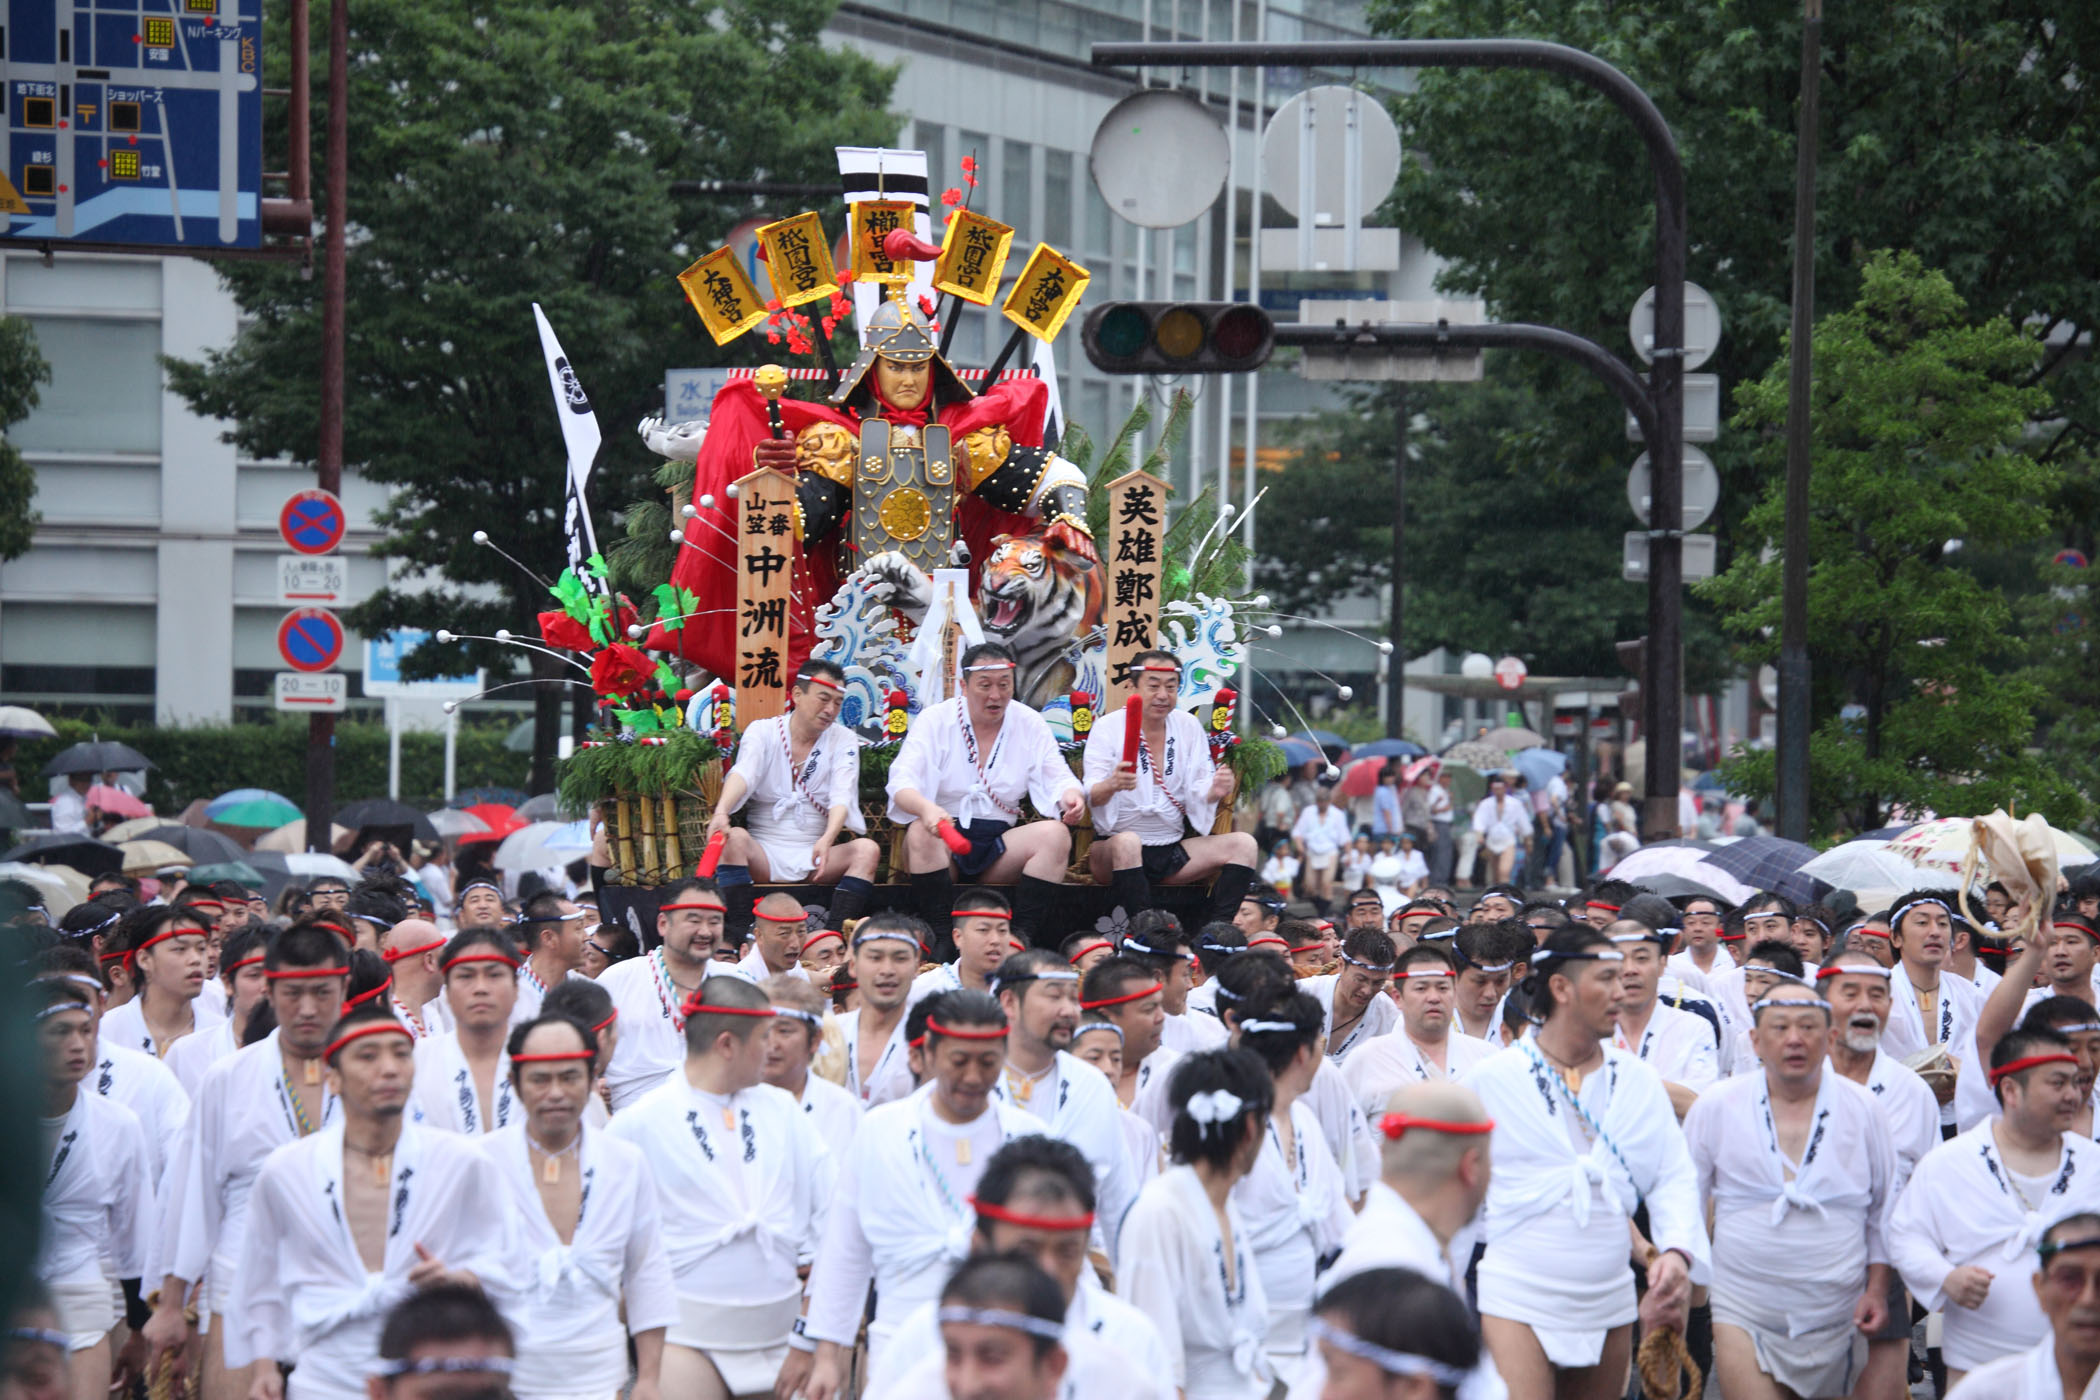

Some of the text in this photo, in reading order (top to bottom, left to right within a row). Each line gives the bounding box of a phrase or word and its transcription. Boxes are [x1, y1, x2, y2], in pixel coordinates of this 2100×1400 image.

[241, 37, 256, 73] KBC
[703, 268, 744, 324] 大神宮
[1025, 267, 1064, 324] 大神宮
[741, 545, 787, 689] 中洲流
